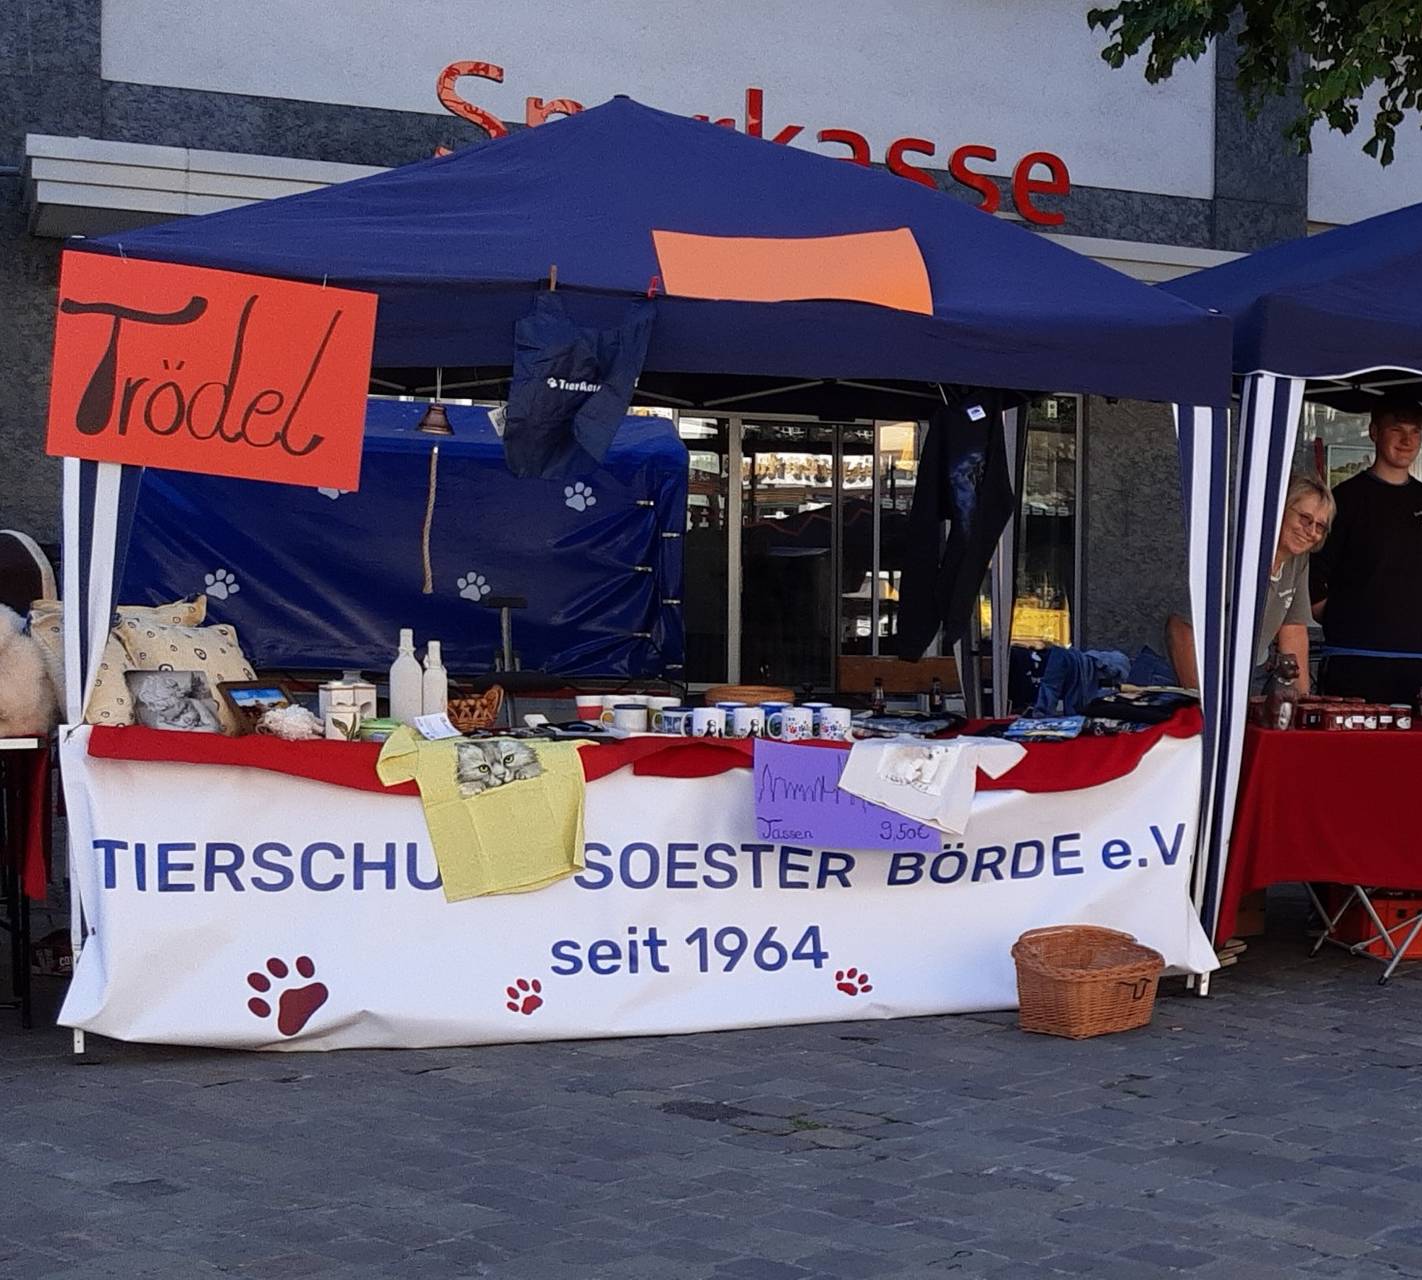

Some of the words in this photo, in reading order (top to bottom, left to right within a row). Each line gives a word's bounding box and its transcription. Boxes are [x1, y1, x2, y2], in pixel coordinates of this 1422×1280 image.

[435, 60, 1071, 226] Skasse
[60, 295, 343, 457] Trödel
[756, 816, 814, 840] Tassen
[92, 839, 445, 893] TIERSCHU
[573, 841, 856, 890] SOESTER
[886, 832, 1084, 886] BÖRDE
[550, 926, 670, 976] seit
[685, 925, 830, 973] 1964
